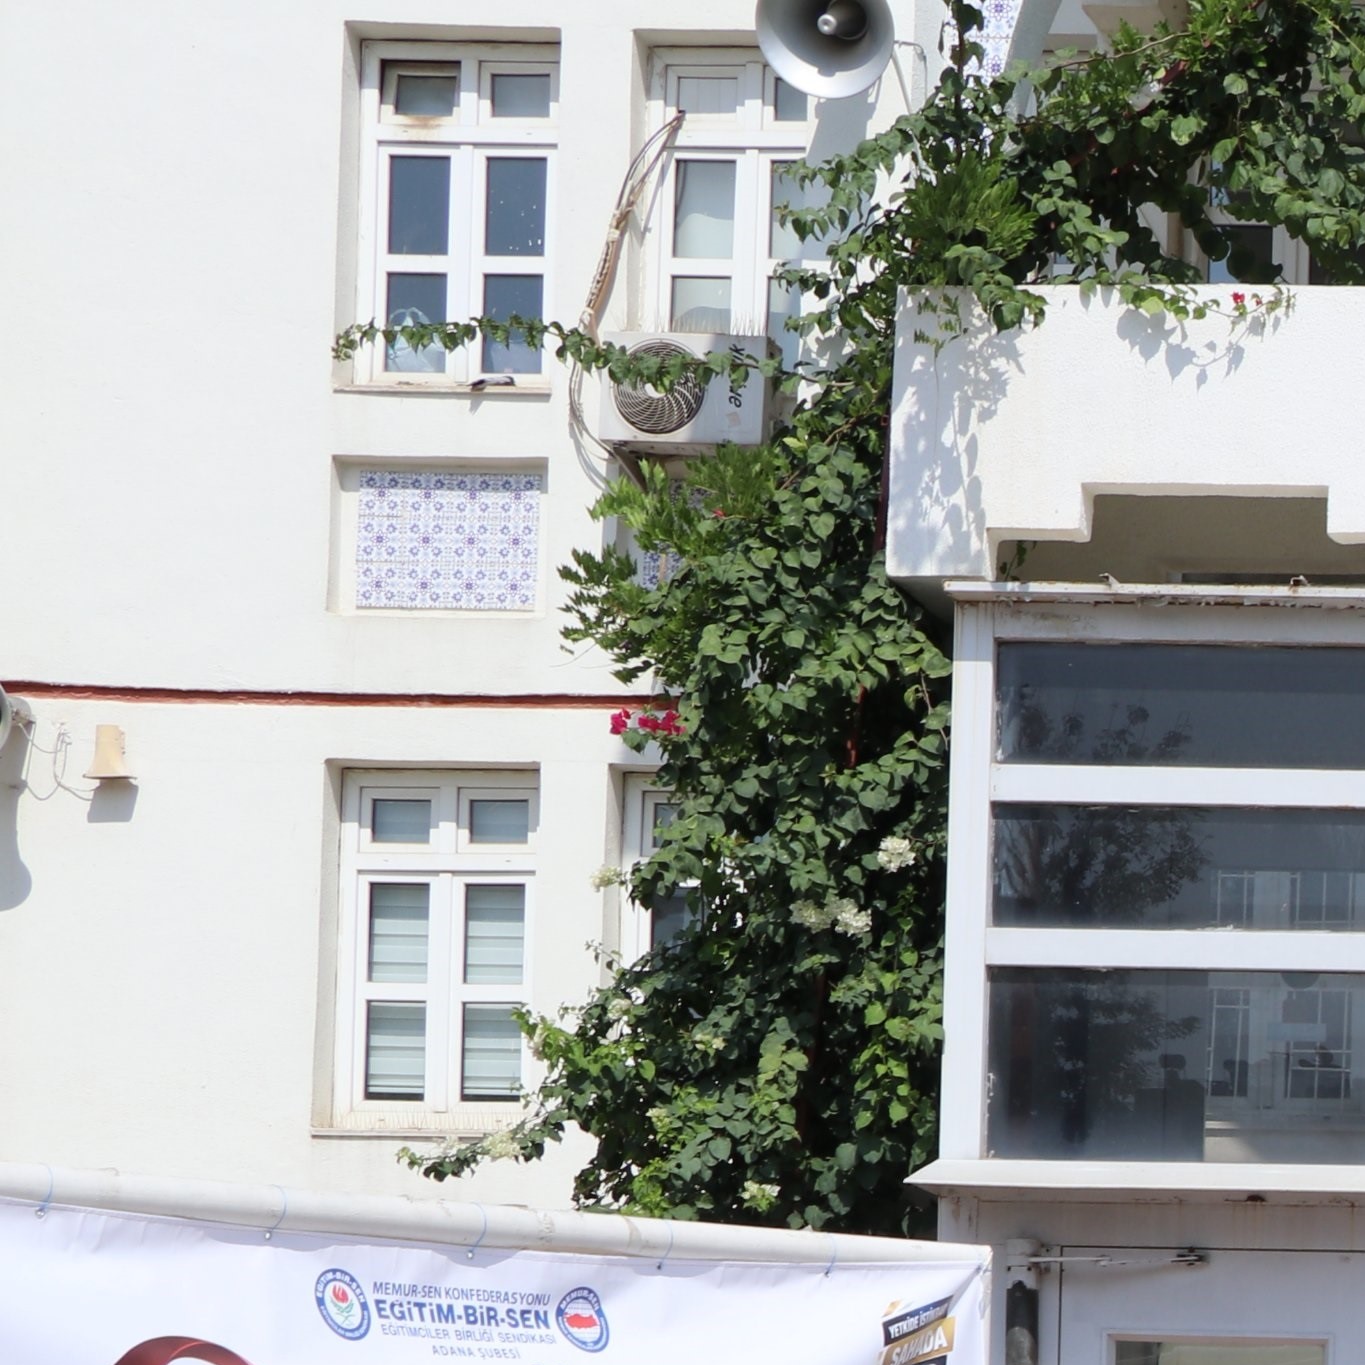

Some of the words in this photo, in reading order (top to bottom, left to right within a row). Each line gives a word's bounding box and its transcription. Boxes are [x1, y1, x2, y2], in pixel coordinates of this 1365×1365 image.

[373, 1281, 442, 1299] MEMUR-SEN
[444, 1286, 552, 1306] KONFEDERASYONU
[381, 1323, 450, 1340] EĞİTİMCİLER
[455, 1328, 495, 1343] BİRLİĞİ
[498, 1331, 557, 1344] SENDİKASI
[431, 1344, 476, 1358] ADANA
[477, 1346, 522, 1360] ŞUBESİ
